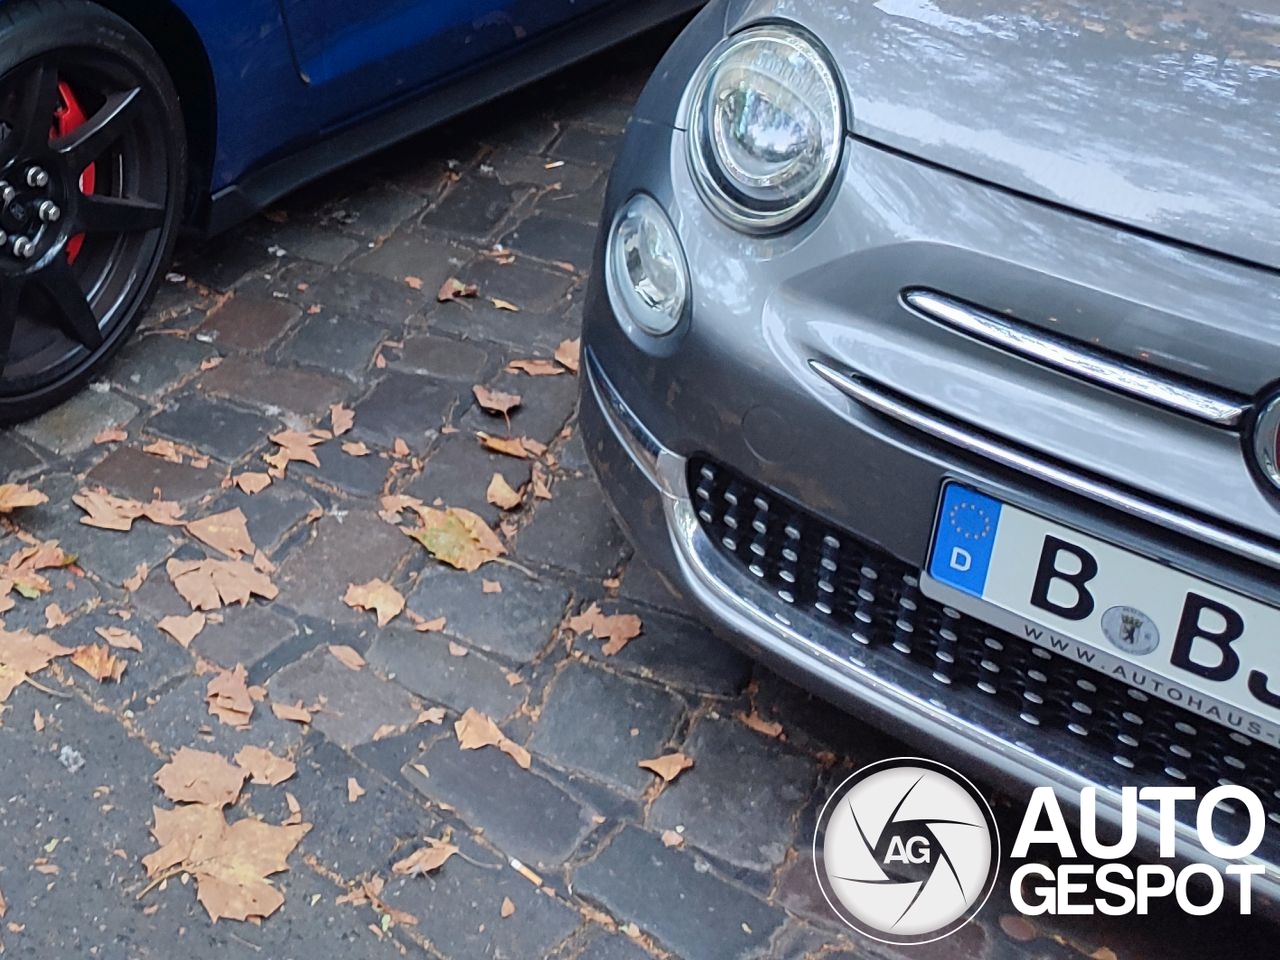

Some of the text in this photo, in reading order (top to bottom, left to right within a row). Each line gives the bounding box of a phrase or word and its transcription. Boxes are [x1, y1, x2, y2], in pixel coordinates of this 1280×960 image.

[949, 546, 972, 572] D
[1030, 534, 1099, 621] B
[1023, 624, 1280, 748] WWW.AUTOHAUS-
